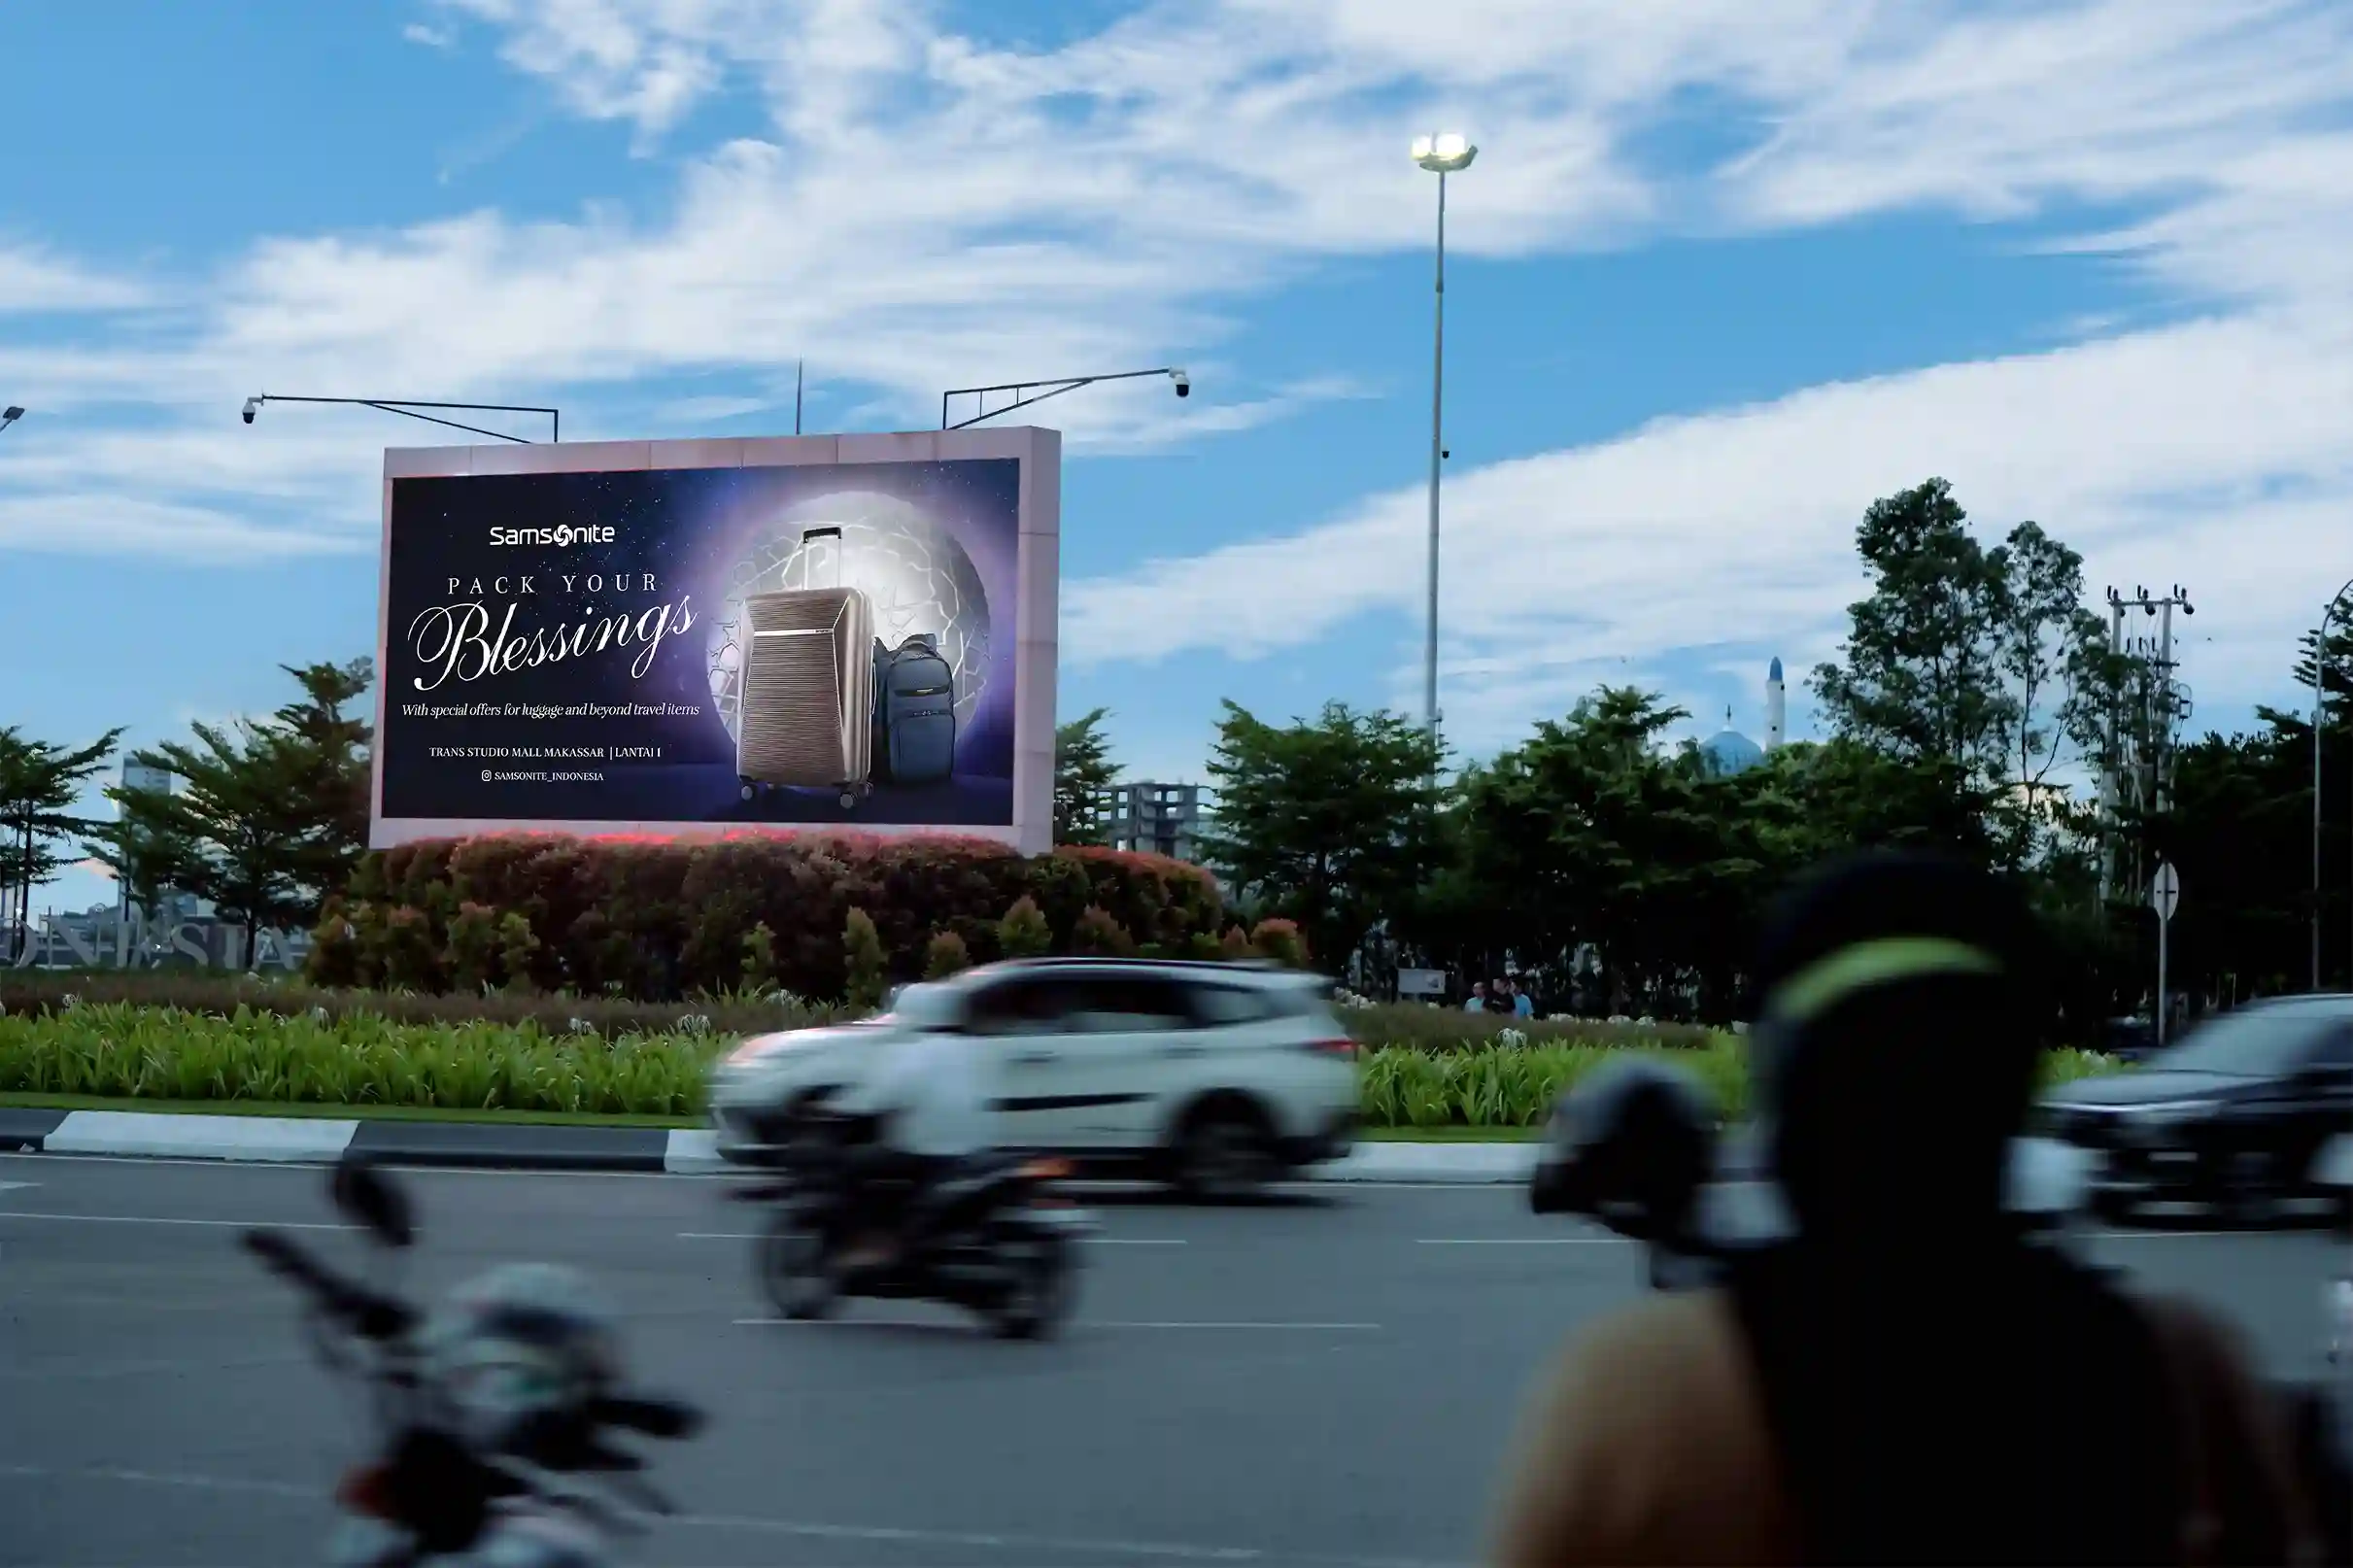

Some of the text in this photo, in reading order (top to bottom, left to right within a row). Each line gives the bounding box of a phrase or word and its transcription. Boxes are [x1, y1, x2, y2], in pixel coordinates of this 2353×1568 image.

[489, 524, 616, 548] Samsonite
[448, 572, 658, 594] PACK YOUR
[407, 595, 699, 692] Blessings
[402, 702, 700, 719] With special offers for luggage and beyond travel items
[428, 747, 465, 758] TRANS
[467, 747, 509, 758] STUDIO
[512, 747, 542, 758] MALL
[544, 747, 605, 758] MAKASSAR
[615, 747, 654, 758] LANTAI
[494, 770, 604, 783] SAMSONITE_INDONESIA
